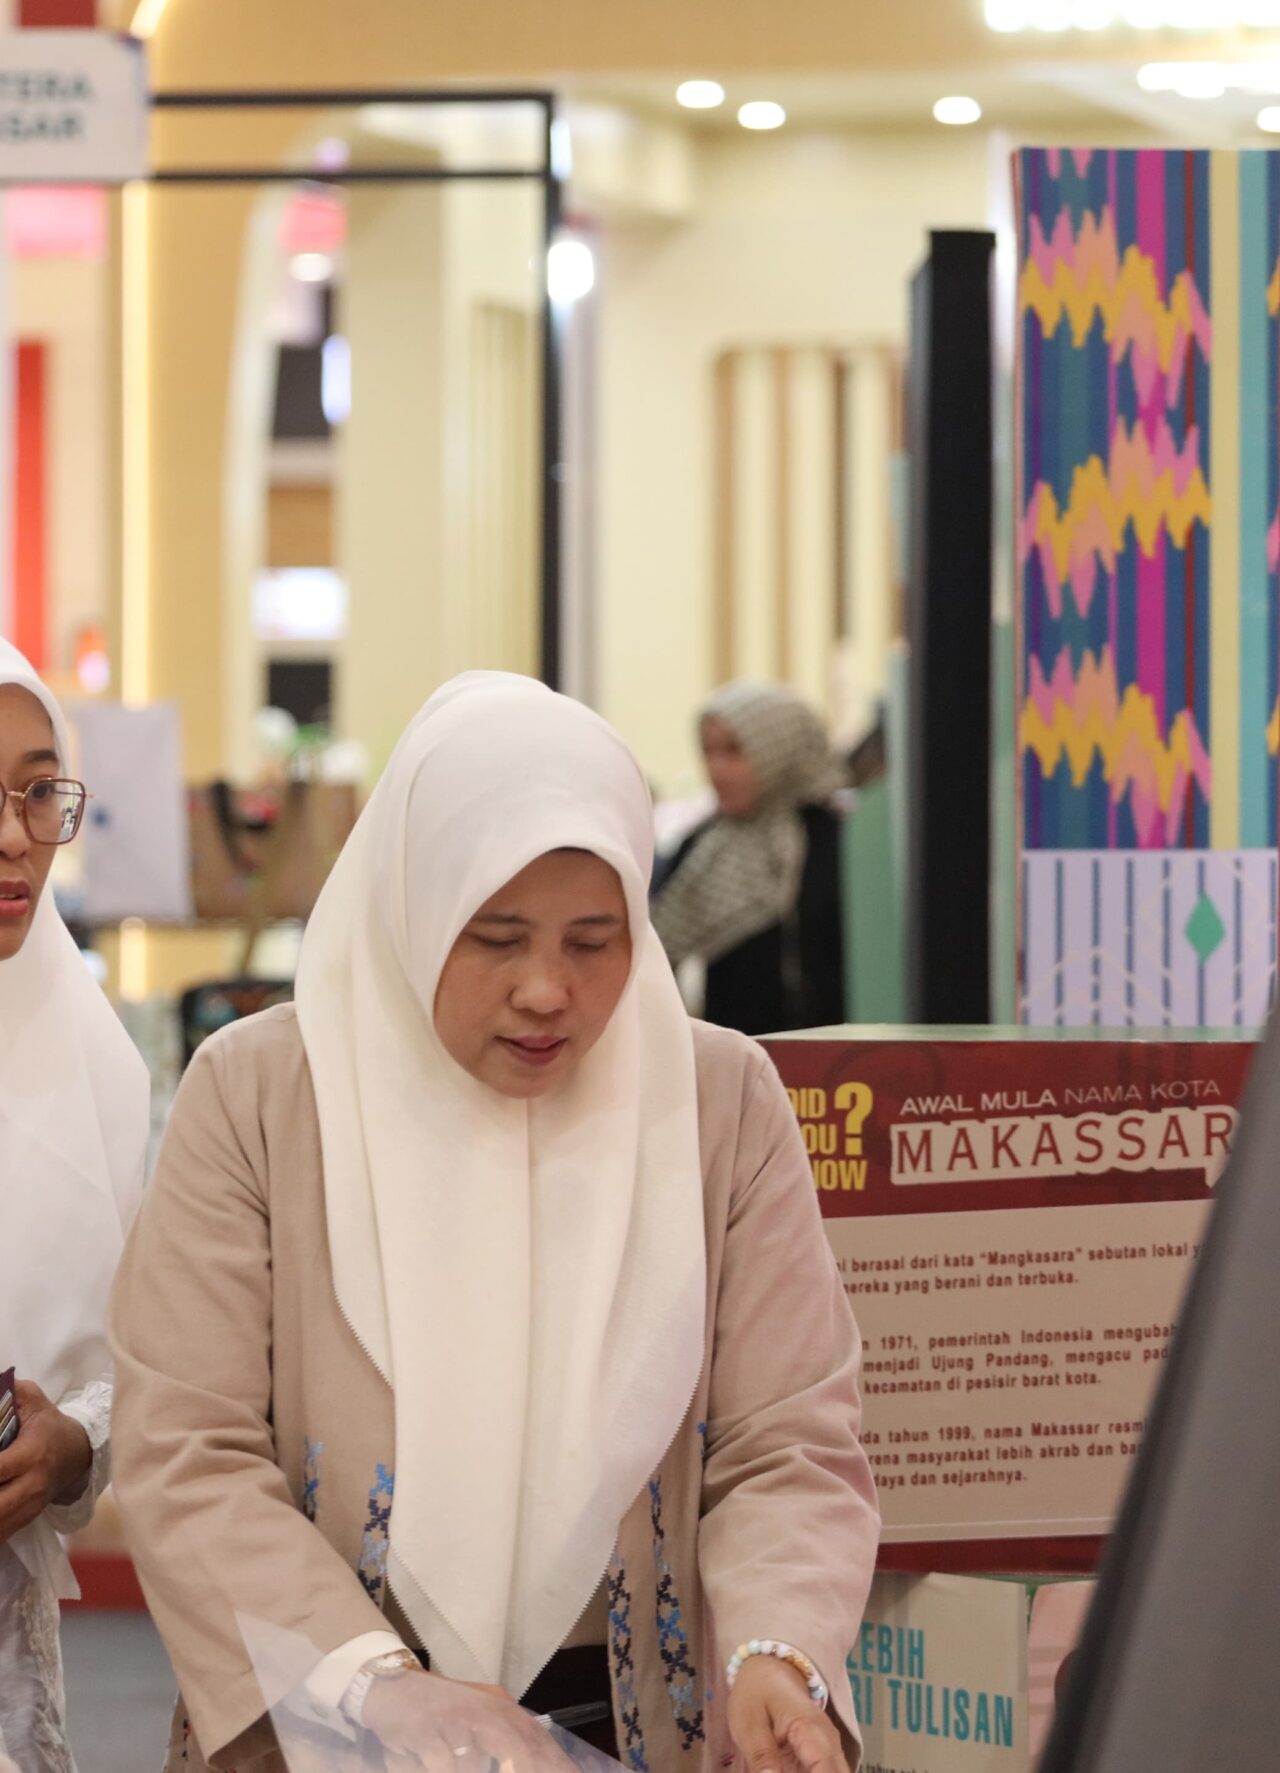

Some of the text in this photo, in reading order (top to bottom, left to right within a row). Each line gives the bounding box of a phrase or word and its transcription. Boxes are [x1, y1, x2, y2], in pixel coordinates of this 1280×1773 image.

[899, 1079, 1220, 1116] AWAL MULA NAMA KOTA
[834, 1081, 873, 1156] ?
[897, 1112, 1234, 1174] MAKASSAR
[852, 1256, 905, 1272] berasal
[910, 1255, 938, 1269] dari
[944, 1253, 974, 1267] kata
[1088, 1246, 1147, 1261] sebutan
[1152, 1243, 1188, 1258] lokal
[894, 1279, 929, 1294] yang
[935, 1275, 981, 1290] berani
[986, 1274, 1013, 1287] dan
[1018, 1270, 1079, 1285] terbuka.
[881, 1335, 918, 1350] 1971,
[928, 1332, 1011, 1351] pemerintah
[1021, 1327, 1093, 1344] Indonesia
[863, 1356, 920, 1375] menjadi
[931, 1355, 974, 1372] Ujung
[986, 1351, 1053, 1368] Pandang,
[1065, 1350, 1131, 1366] mengacu
[864, 1371, 1102, 1394] kecamatan di pesisir barat kota.
[888, 1428, 929, 1443] tahun
[938, 1425, 976, 1442] 1999,
[984, 1426, 1022, 1439] nama
[1031, 1422, 1100, 1437] Makassar
[906, 1447, 990, 1466] masyarakat
[996, 1443, 1033, 1460] lebih
[1040, 1443, 1080, 1458] akrab
[1087, 1442, 1114, 1457] dan
[910, 1471, 936, 1486] dan
[942, 1468, 1027, 1487] sejarahnya.
[887, 1678, 1013, 1748] TULISAN
